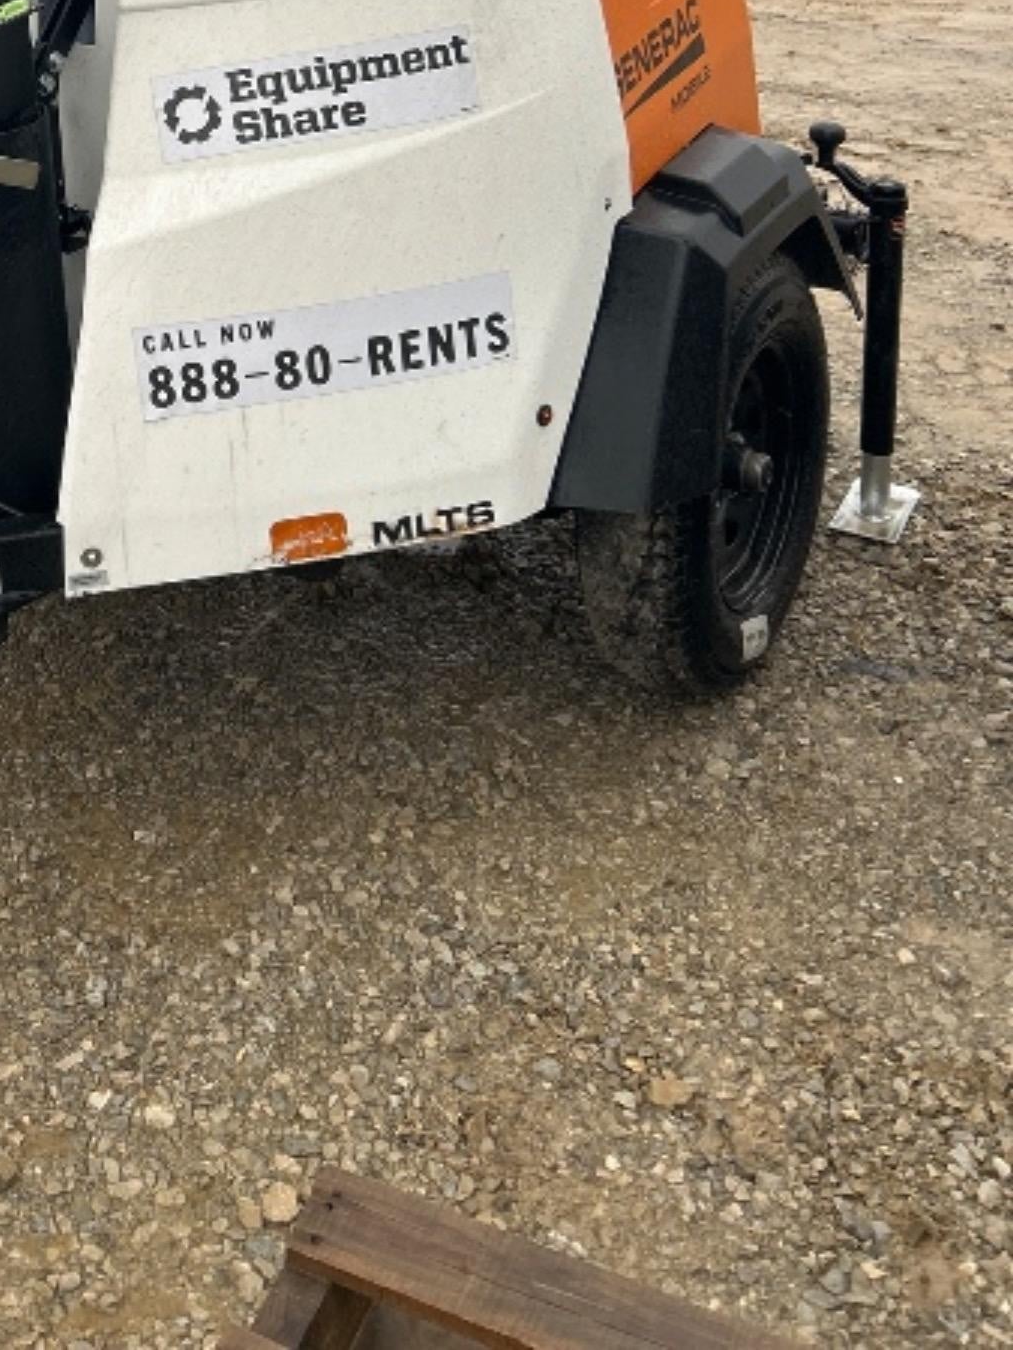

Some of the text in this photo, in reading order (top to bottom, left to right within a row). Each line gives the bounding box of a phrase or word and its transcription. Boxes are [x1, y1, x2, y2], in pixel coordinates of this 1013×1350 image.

[225, 34, 471, 106] Equipment
[232, 100, 367, 145] Share
[142, 318, 276, 355] CALL NOW
[147, 310, 510, 410] 888-80-RENTS
